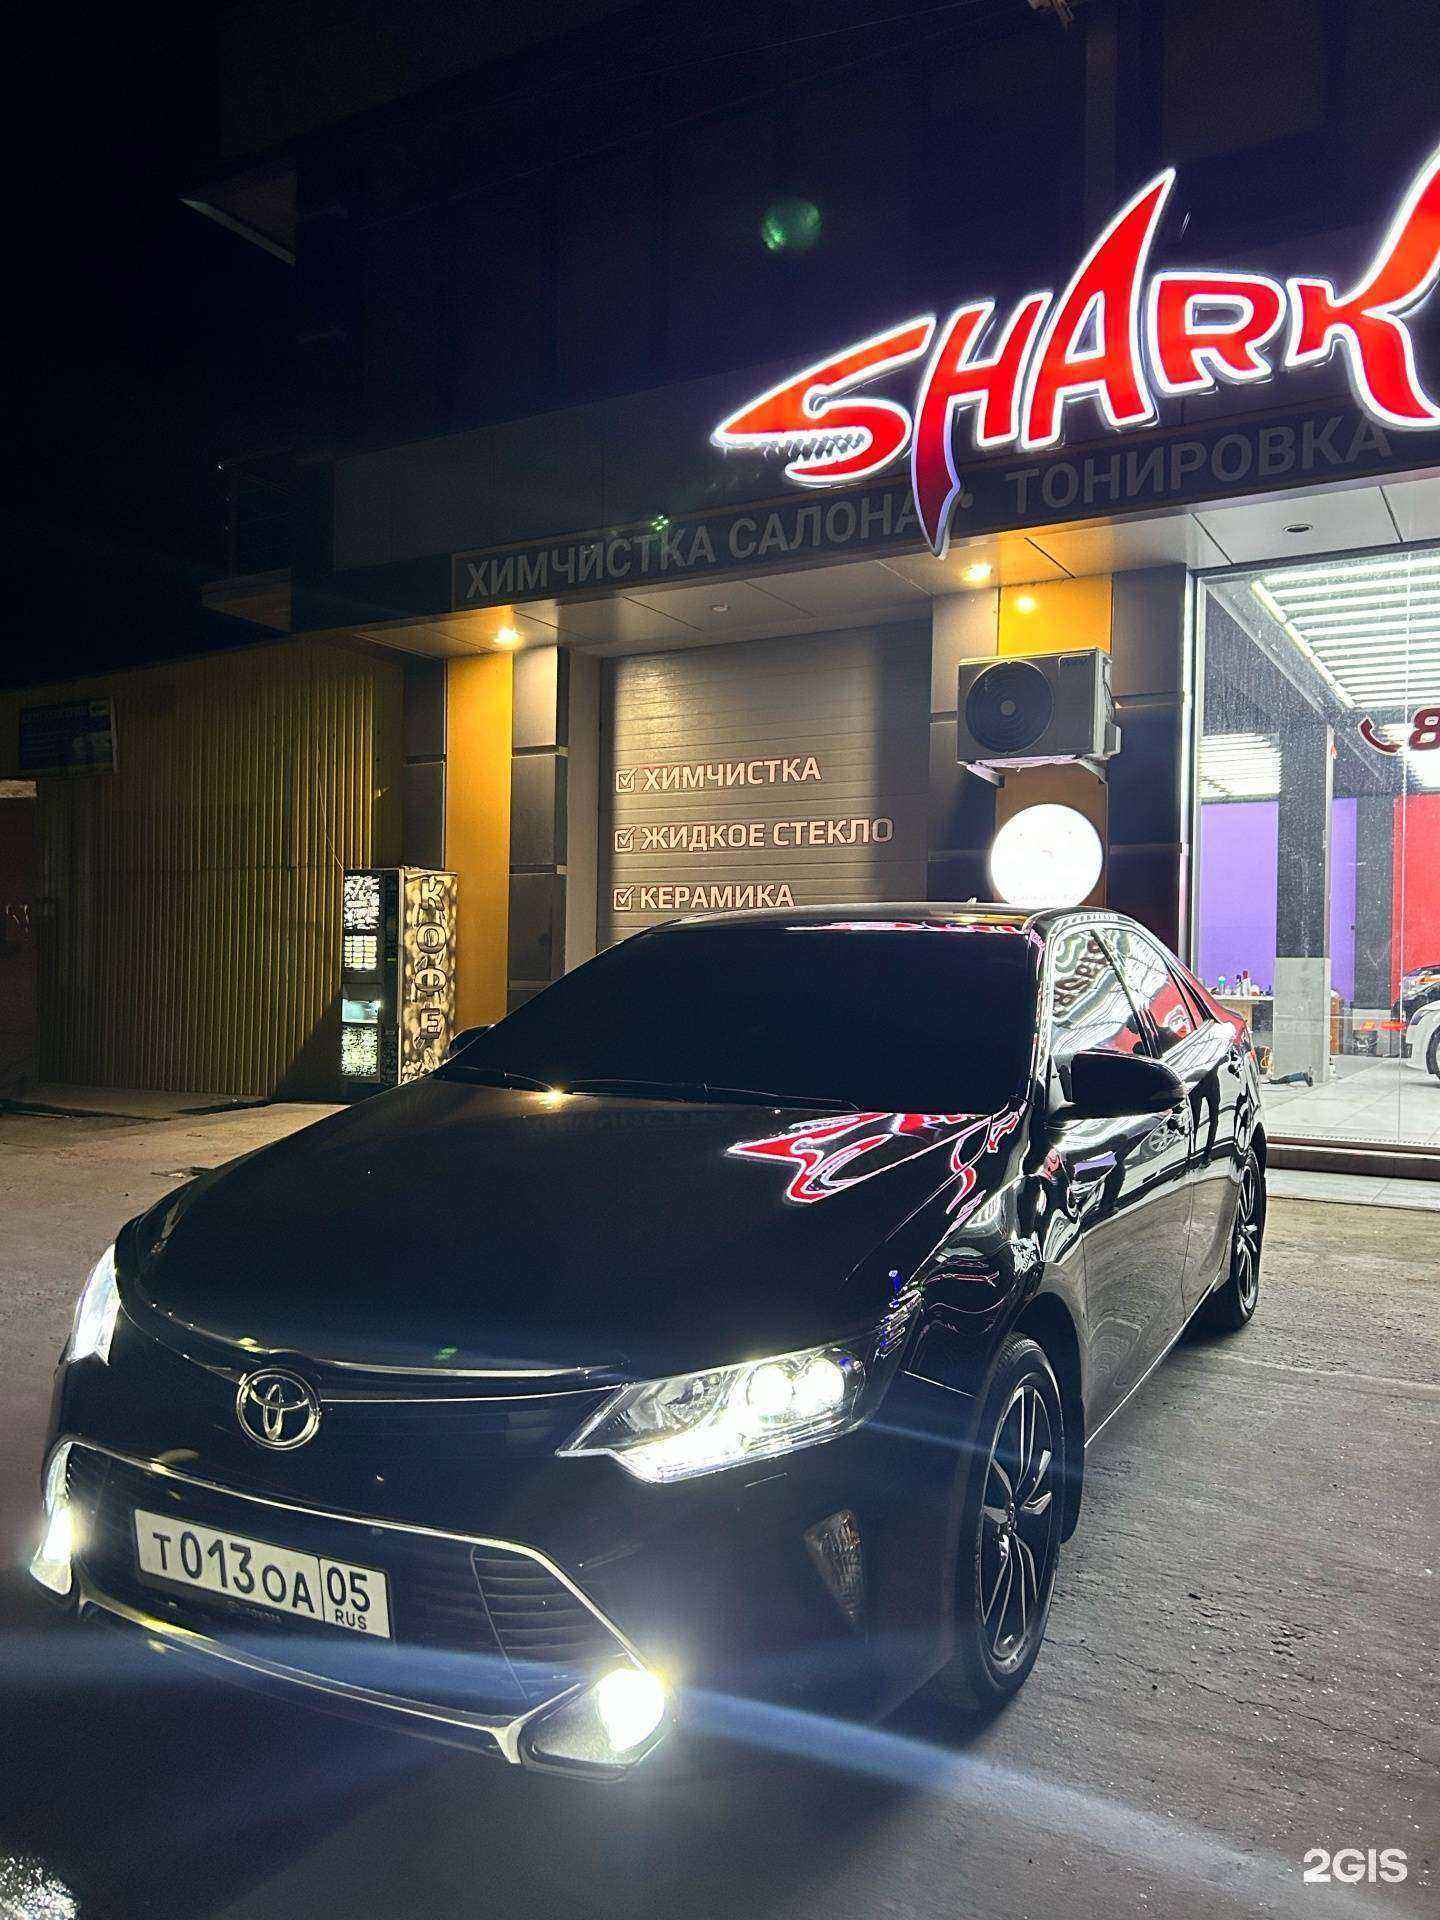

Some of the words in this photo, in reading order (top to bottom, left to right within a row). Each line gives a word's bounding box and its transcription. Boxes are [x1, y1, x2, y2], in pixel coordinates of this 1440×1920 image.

[710, 145, 1440, 558] SHARK
[465, 525, 718, 598] ХИМЧИСТКА
[1004, 415, 1394, 515] ТОНИРОВКА
[642, 756, 822, 791] ХИМЧИСТКА
[641, 822, 765, 851] ЖИДКОЕ
[772, 817, 894, 846] СТЕКЛО
[639, 883, 796, 909] КЕРАМИКА
[415, 878, 447, 1041] КОФЕ
[326, 1566, 371, 1612] 05
[334, 1608, 367, 1631] RUS
